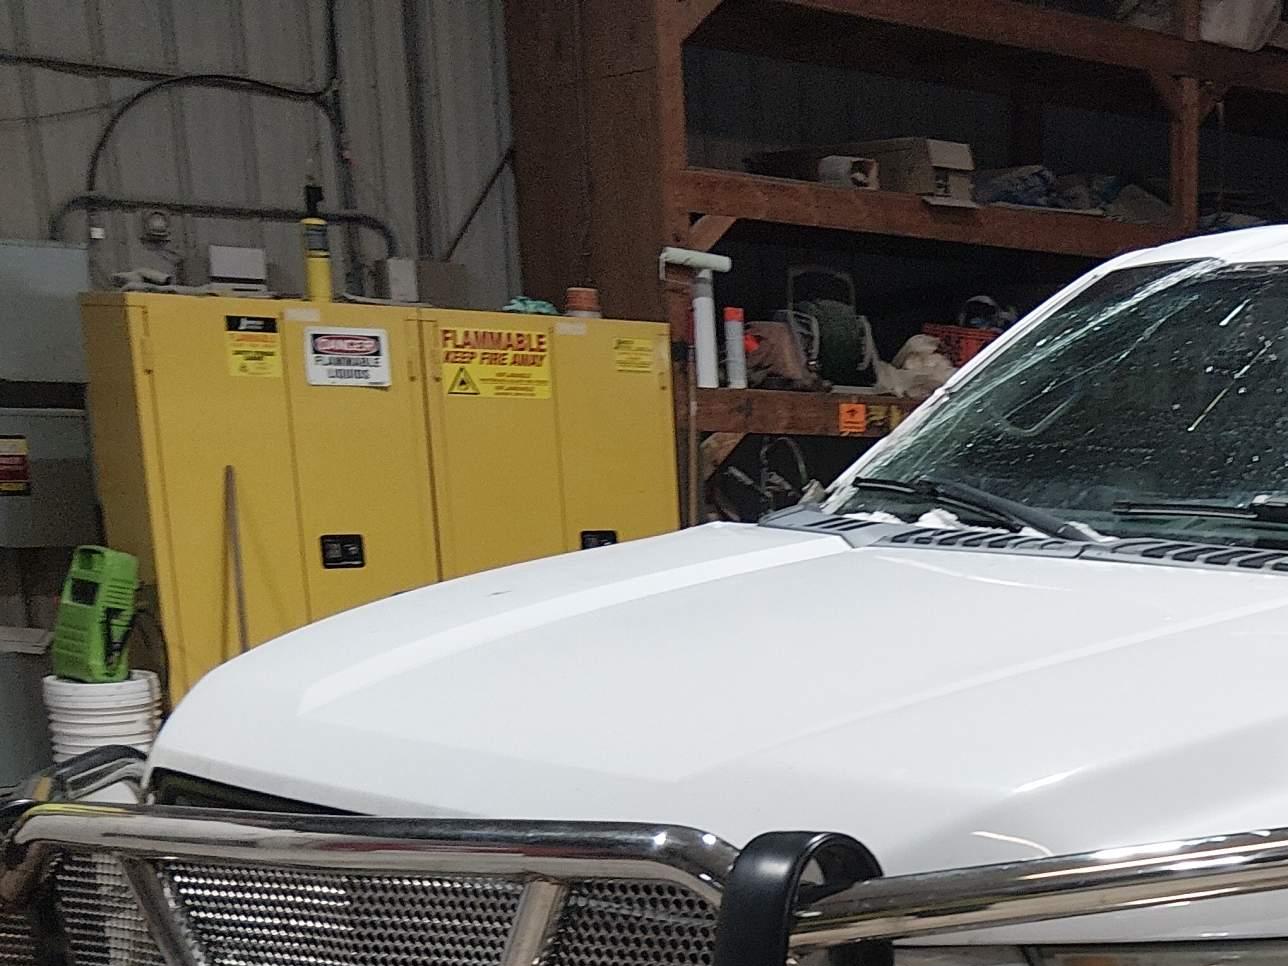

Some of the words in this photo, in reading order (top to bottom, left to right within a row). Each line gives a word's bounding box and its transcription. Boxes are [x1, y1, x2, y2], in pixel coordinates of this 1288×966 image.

[441, 329, 547, 352] FLAMMABLE
[444, 350, 477, 365] KEEP
[479, 351, 509, 366] FIRE
[510, 353, 547, 367] AWAY
